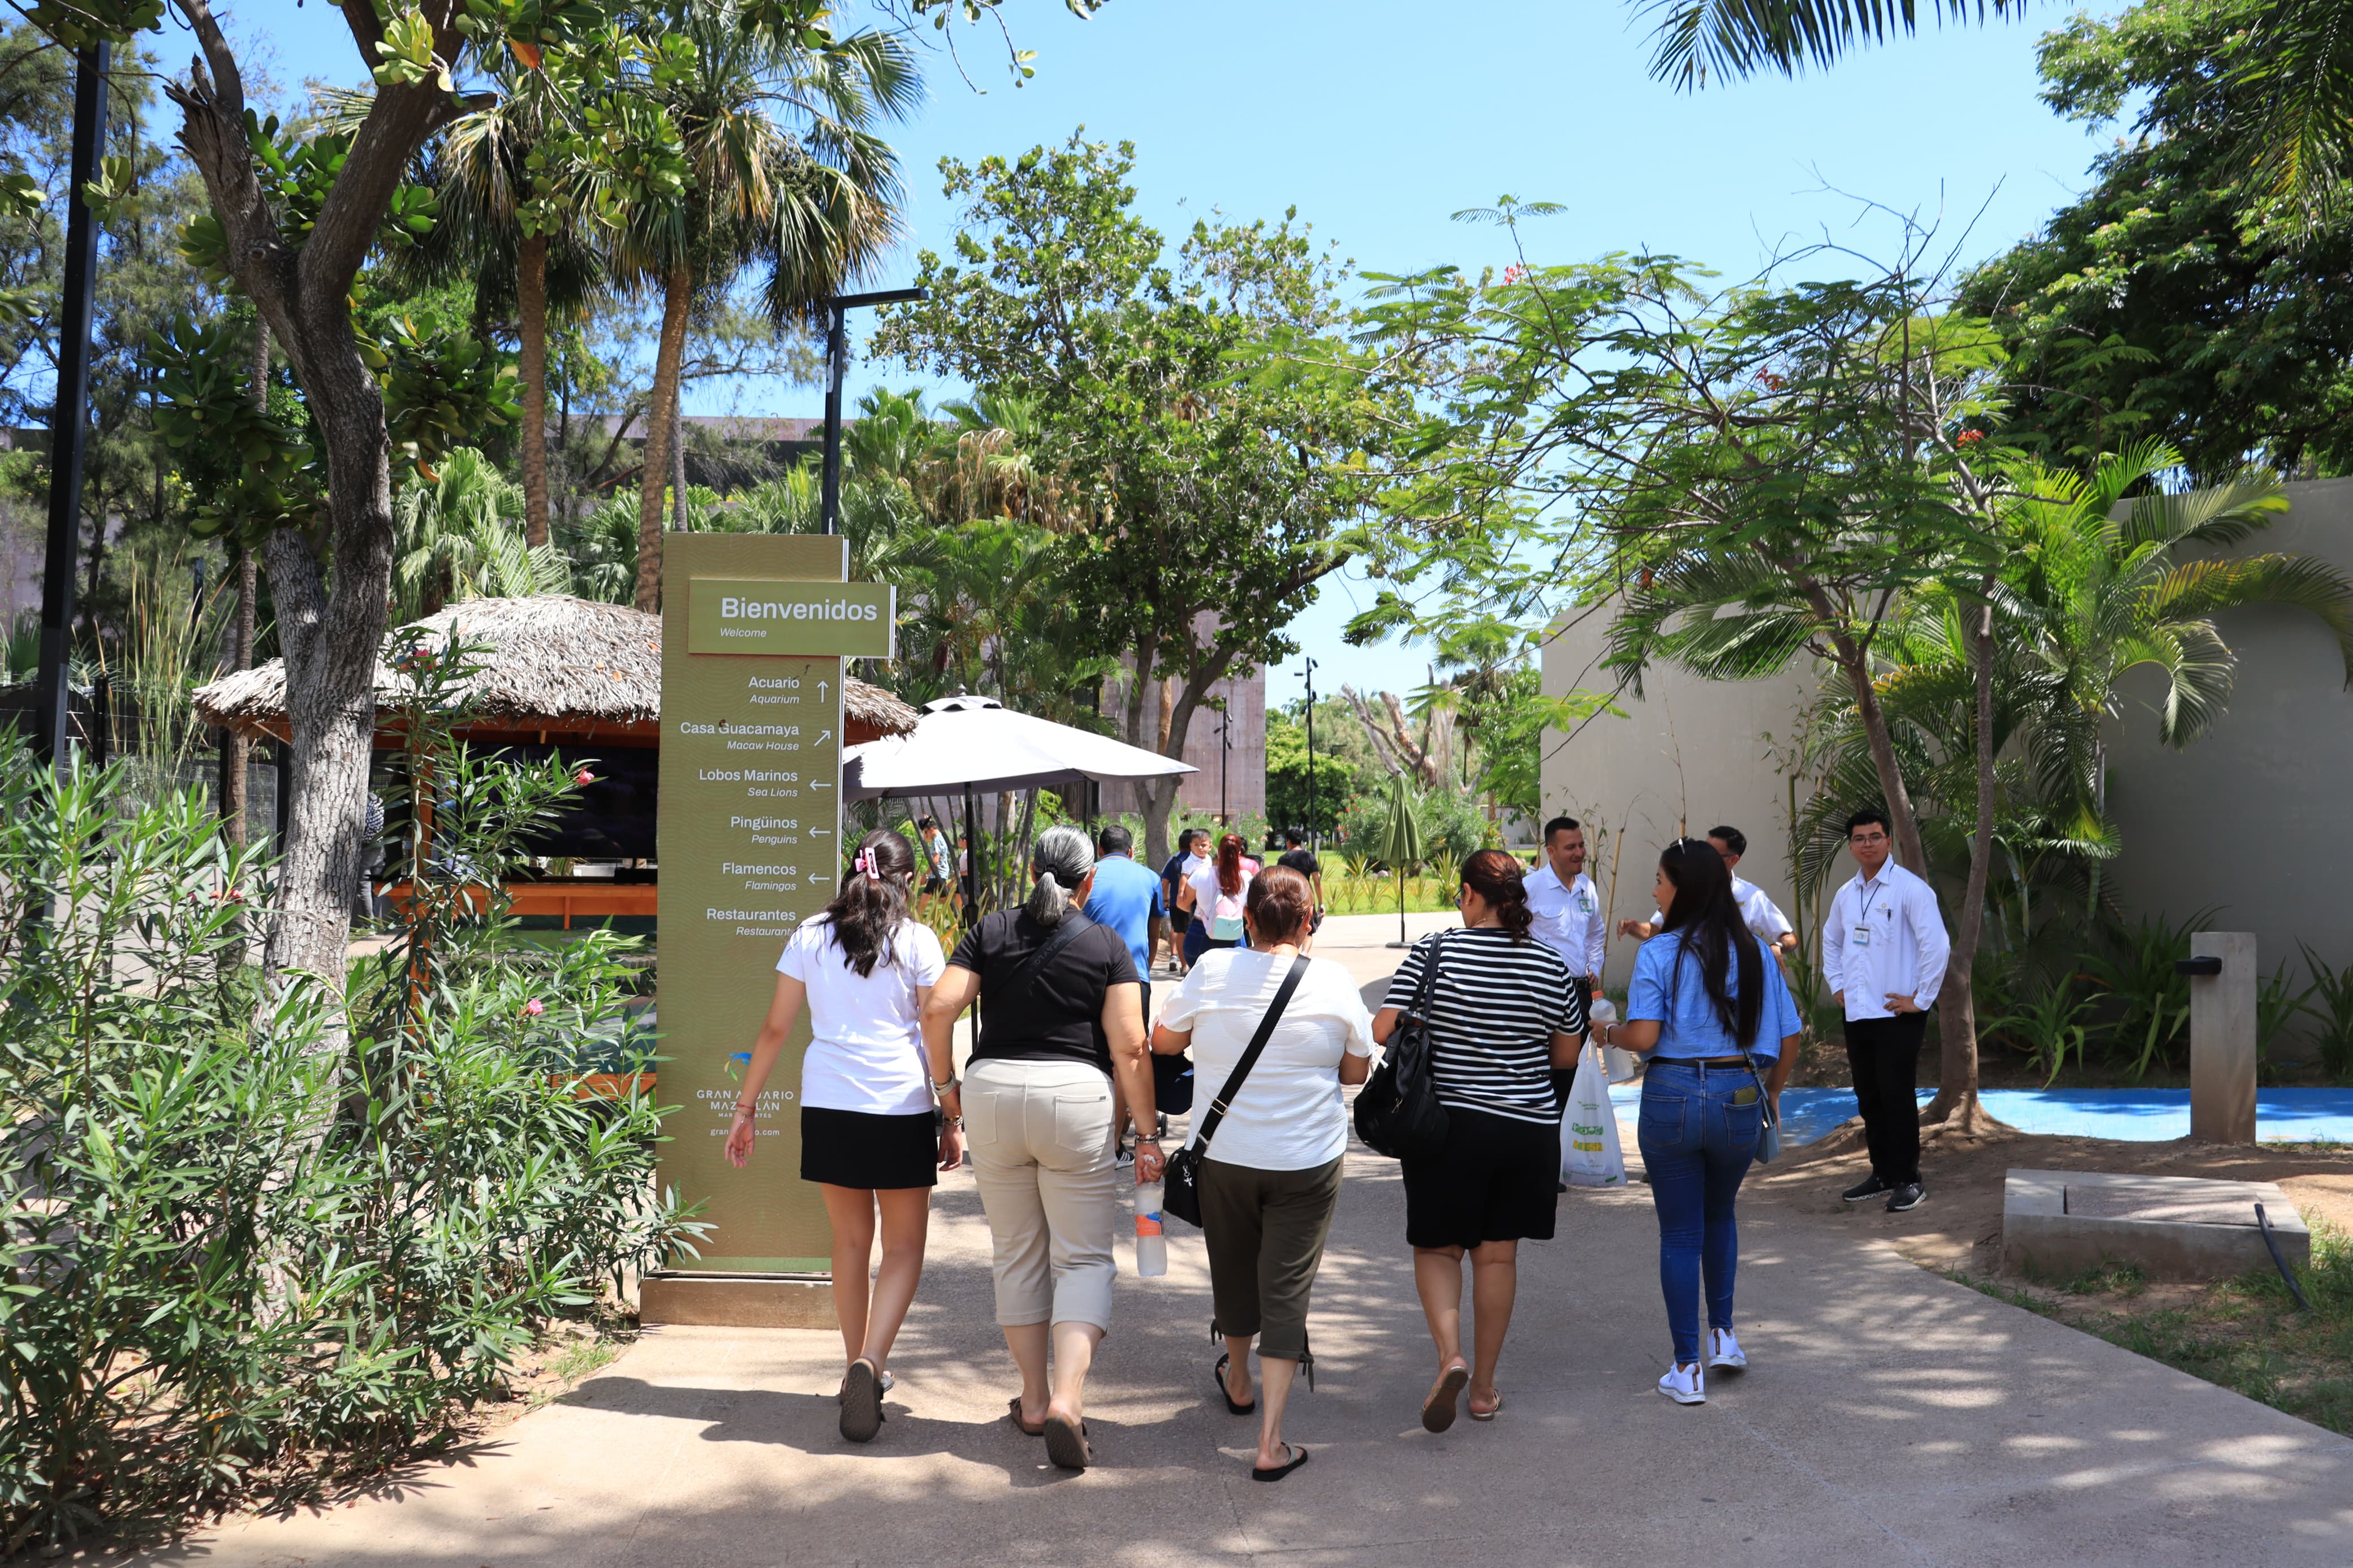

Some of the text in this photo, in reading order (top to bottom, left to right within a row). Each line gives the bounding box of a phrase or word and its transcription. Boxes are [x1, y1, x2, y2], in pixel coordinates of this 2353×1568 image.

[722, 597, 877, 621] Bienvenidos
[720, 628, 767, 637] Welcome
[748, 676, 800, 689] Acuario
[749, 694, 800, 705] Aquarium
[680, 722, 799, 737] Casa Guacamaya
[727, 741, 799, 750] Macaw House
[699, 768, 798, 781] Lobos Marinos
[748, 787, 798, 797] Sea Lions
[731, 816, 798, 831] Pingüinos
[751, 834, 798, 845] Penguins
[722, 862, 796, 875] Flamencos
[745, 880, 796, 892] Flamingos
[707, 908, 796, 921] Restaurantes
[696, 1090, 731, 1099] GRAN
[710, 1100, 780, 1111] MAZLÁN
